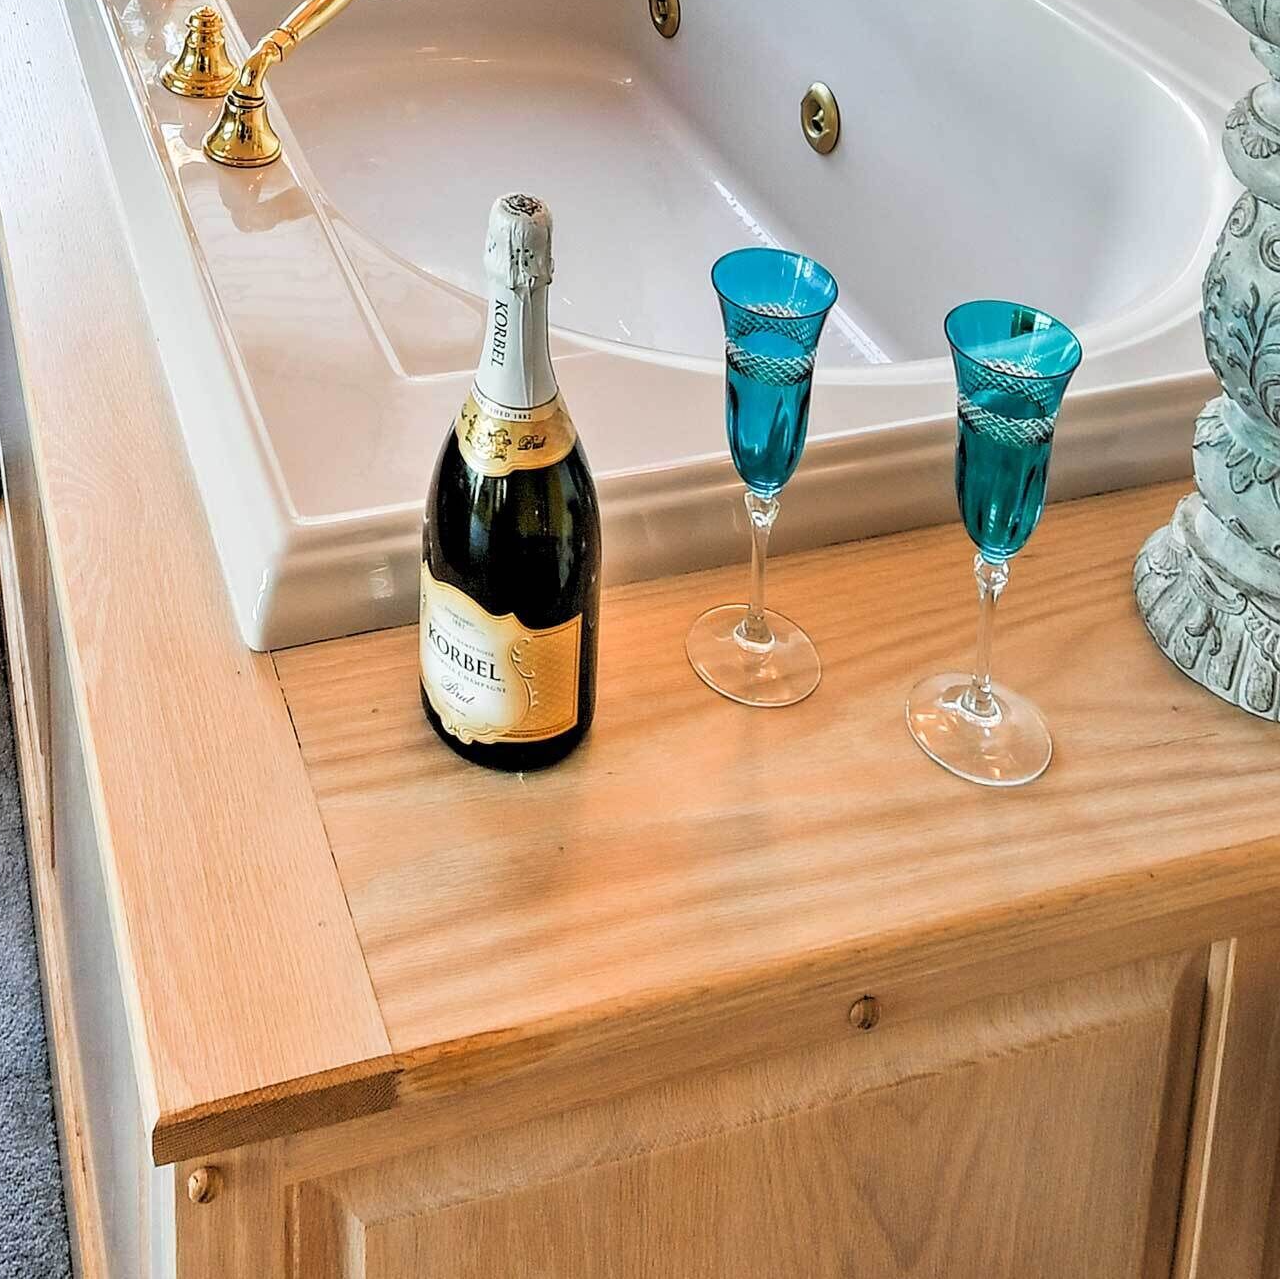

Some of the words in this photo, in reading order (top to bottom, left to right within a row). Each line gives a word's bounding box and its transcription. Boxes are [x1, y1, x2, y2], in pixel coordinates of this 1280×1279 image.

[491, 300, 508, 367] KORBEL
[428, 622, 501, 681] KORBEL
[440, 675, 476, 703] Brut
